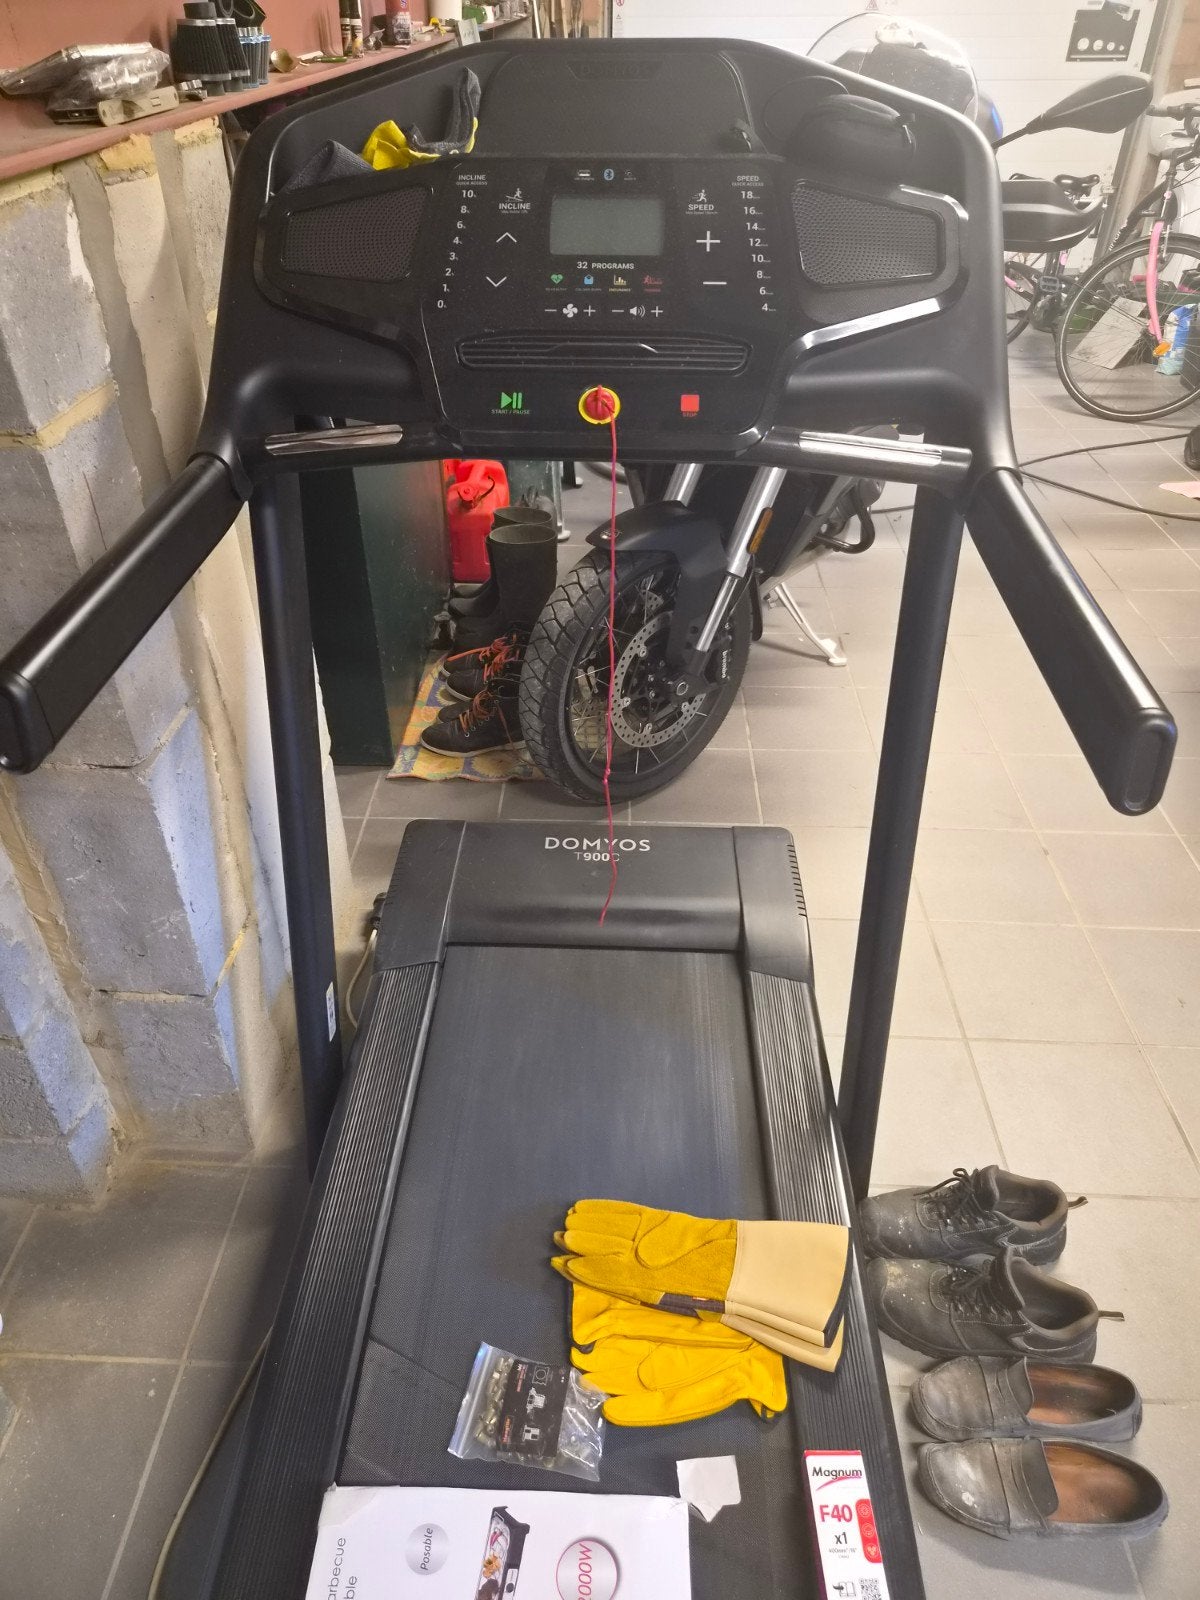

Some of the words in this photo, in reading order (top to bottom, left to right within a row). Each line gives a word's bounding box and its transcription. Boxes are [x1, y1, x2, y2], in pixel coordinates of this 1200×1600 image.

[498, 202, 531, 210] INCLINE
[688, 203, 715, 211] SPEED
[576, 261, 588, 269] 32
[591, 262, 635, 270] PROGRAMS
[544, 837, 651, 851] DOMYOS
[811, 1465, 863, 1480] Magnum
[819, 1504, 853, 1523] F40
[834, 1531, 848, 1544] x1
[420, 1527, 434, 1571] Posable
[578, 1542, 593, 1600] 000W
